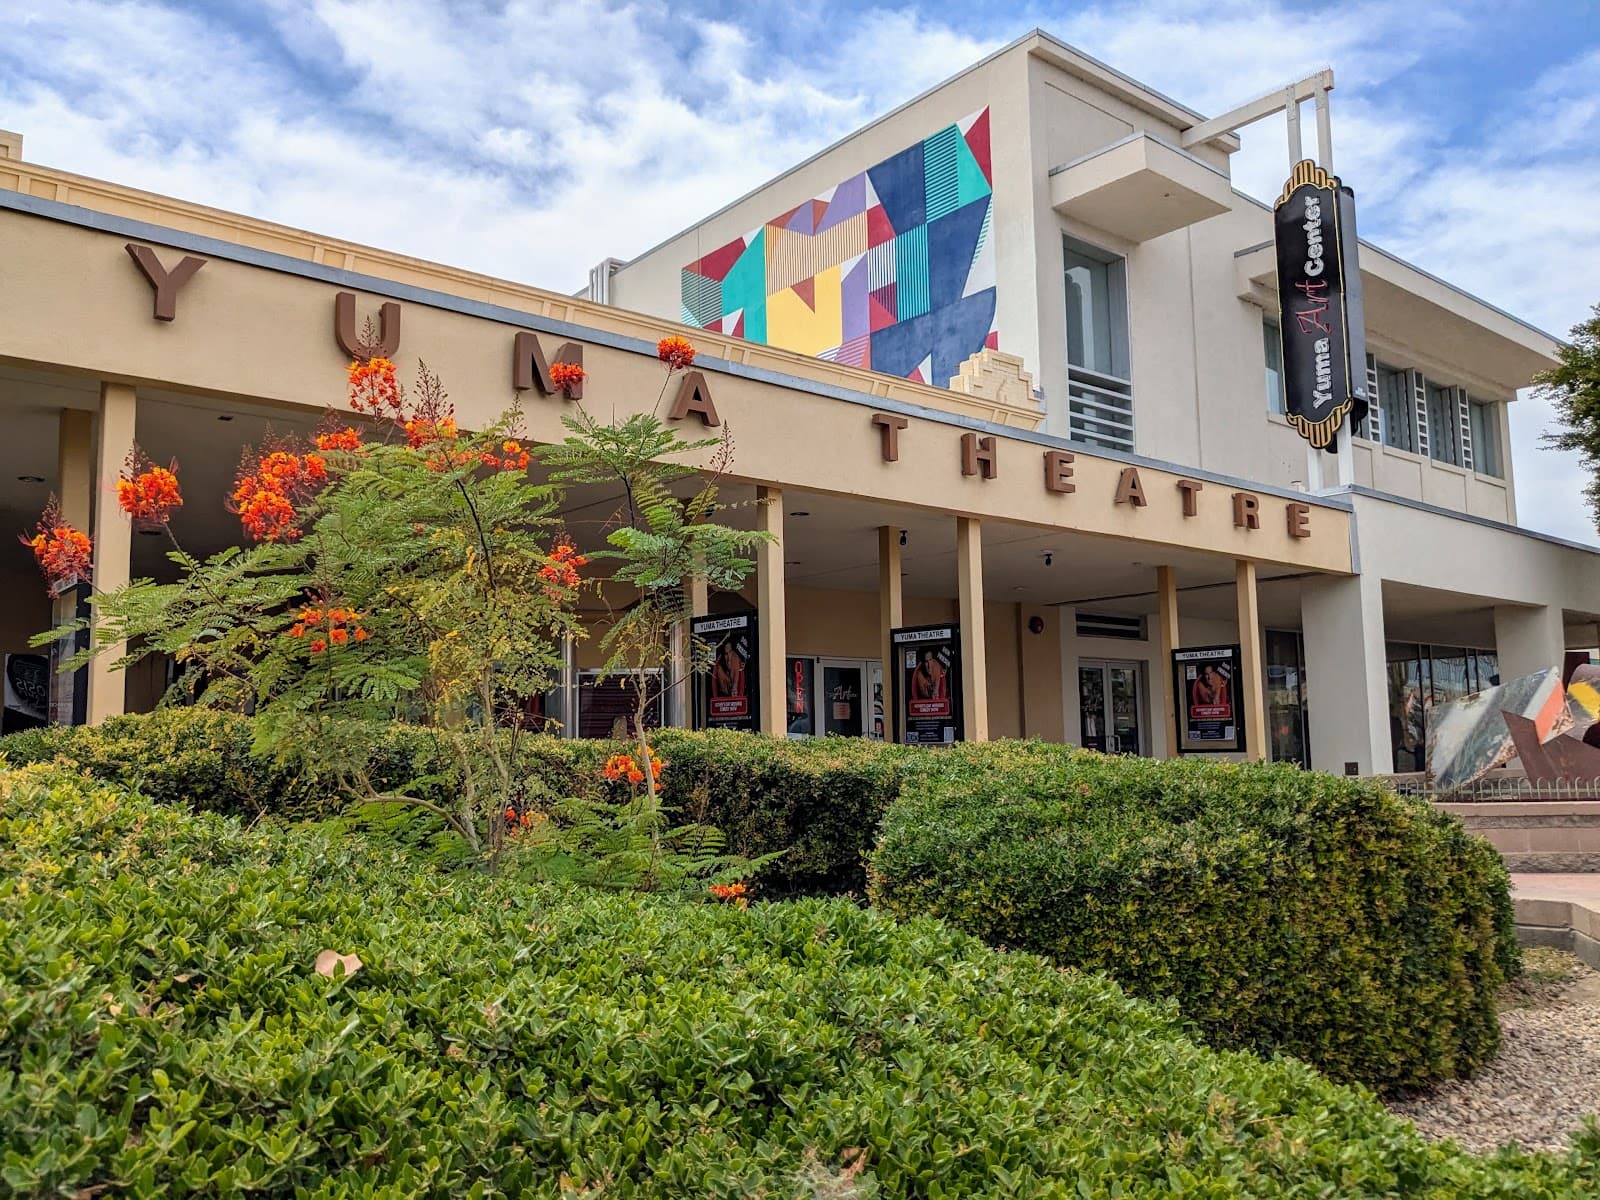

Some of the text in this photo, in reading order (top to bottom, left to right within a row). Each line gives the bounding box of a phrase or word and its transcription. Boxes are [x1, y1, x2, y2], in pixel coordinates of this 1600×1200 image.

[1295, 196, 1333, 409] Yuma Art Center
[125, 242, 1312, 539] YUMA THEATRE
[794, 660, 805, 714] OPEN
[901, 630, 944, 641] YUMA THEATRE
